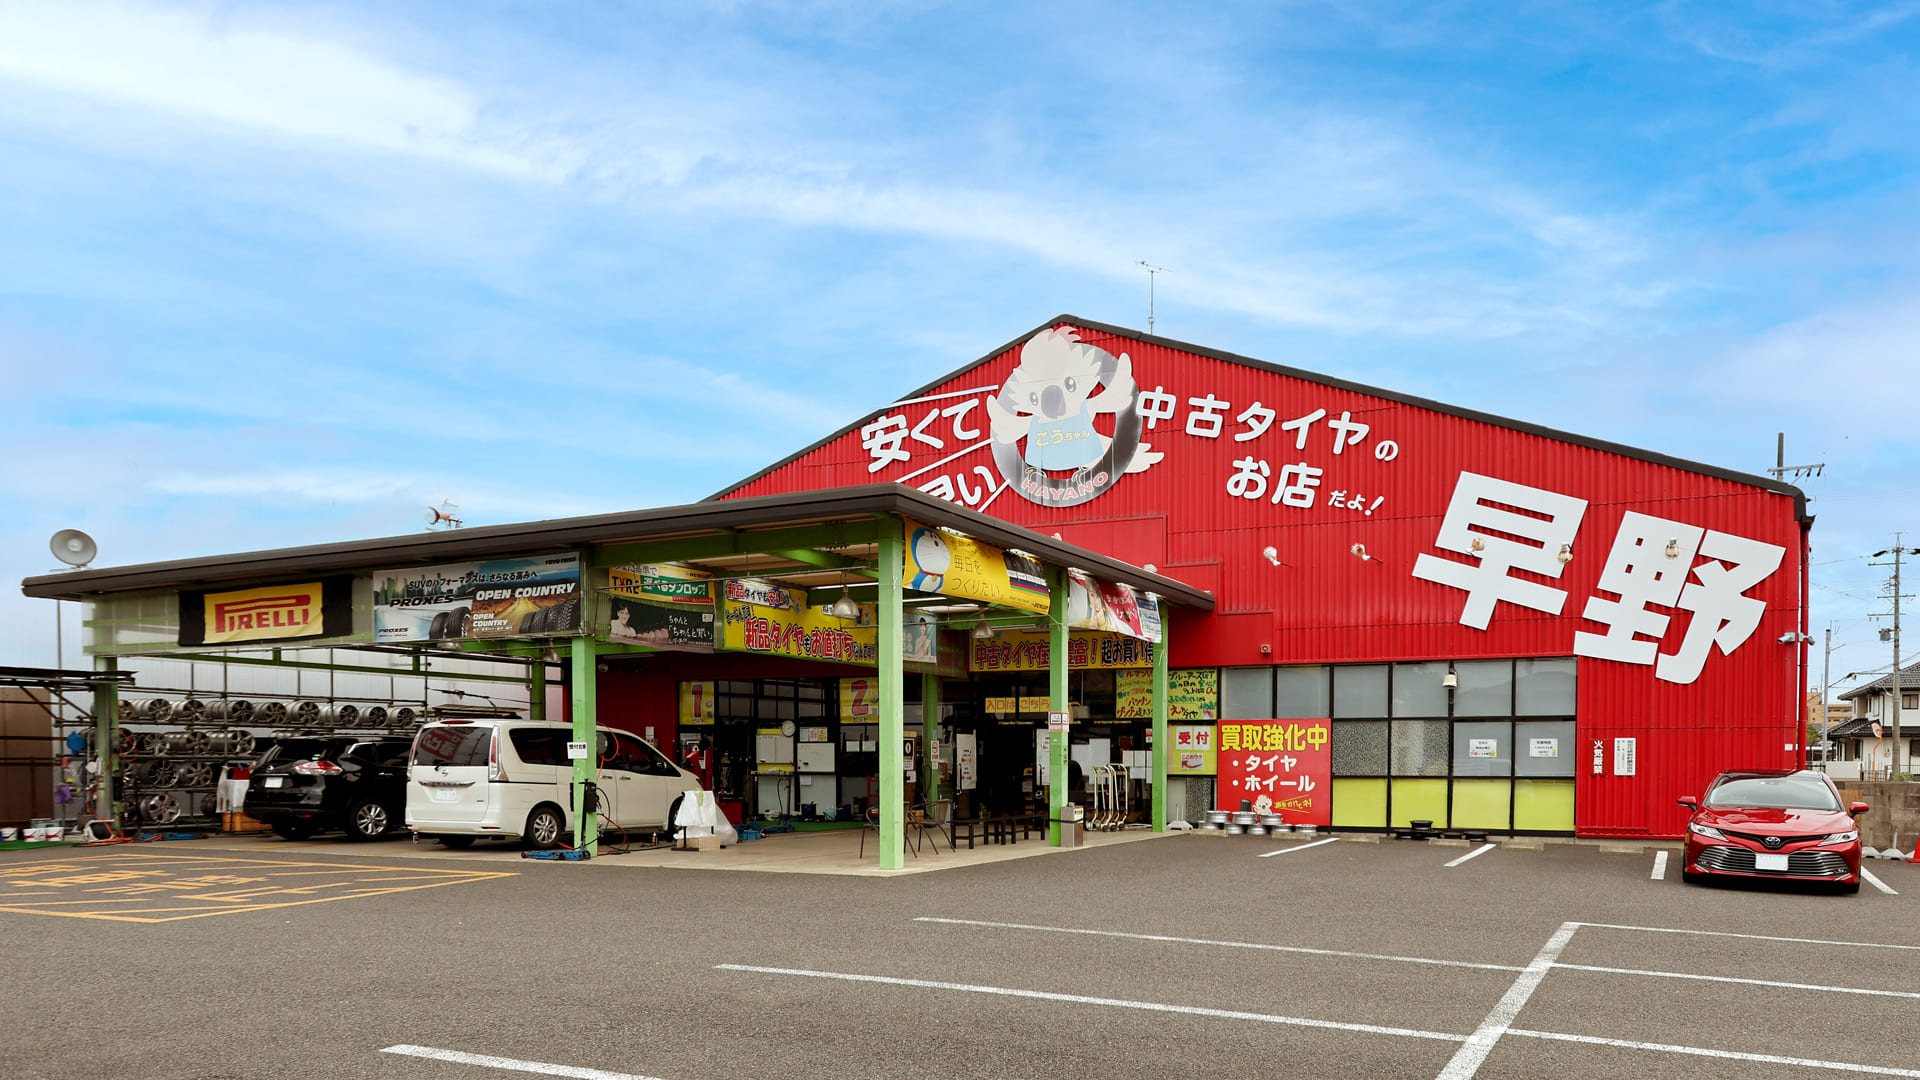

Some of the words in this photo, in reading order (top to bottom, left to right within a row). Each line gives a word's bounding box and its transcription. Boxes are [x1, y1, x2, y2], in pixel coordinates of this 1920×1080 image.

[861, 398, 981, 473] 安くて
[1035, 428, 1091, 448] こうちゃん
[1135, 385, 1400, 463] 中古タイヤの
[1020, 471, 1109, 501] HAYANO
[476, 588, 512, 601] OPEN
[515, 582, 576, 598] COUNTRY
[1411, 470, 1787, 685] 早野
[215, 594, 311, 634] PIRELLI
[390, 595, 455, 607] PROXES
[472, 613, 494, 621] OPEN
[472, 619, 508, 627] COUNTRY
[974, 638, 1098, 669] 中古タイヤ在富!
[692, 684, 703, 718] 1
[851, 679, 869, 716] 2
[986, 700, 1016, 710] 入口は
[1020, 699, 1050, 710] こちら
[1178, 731, 1209, 745] 受付
[1221, 723, 1328, 752] 買取強化中
